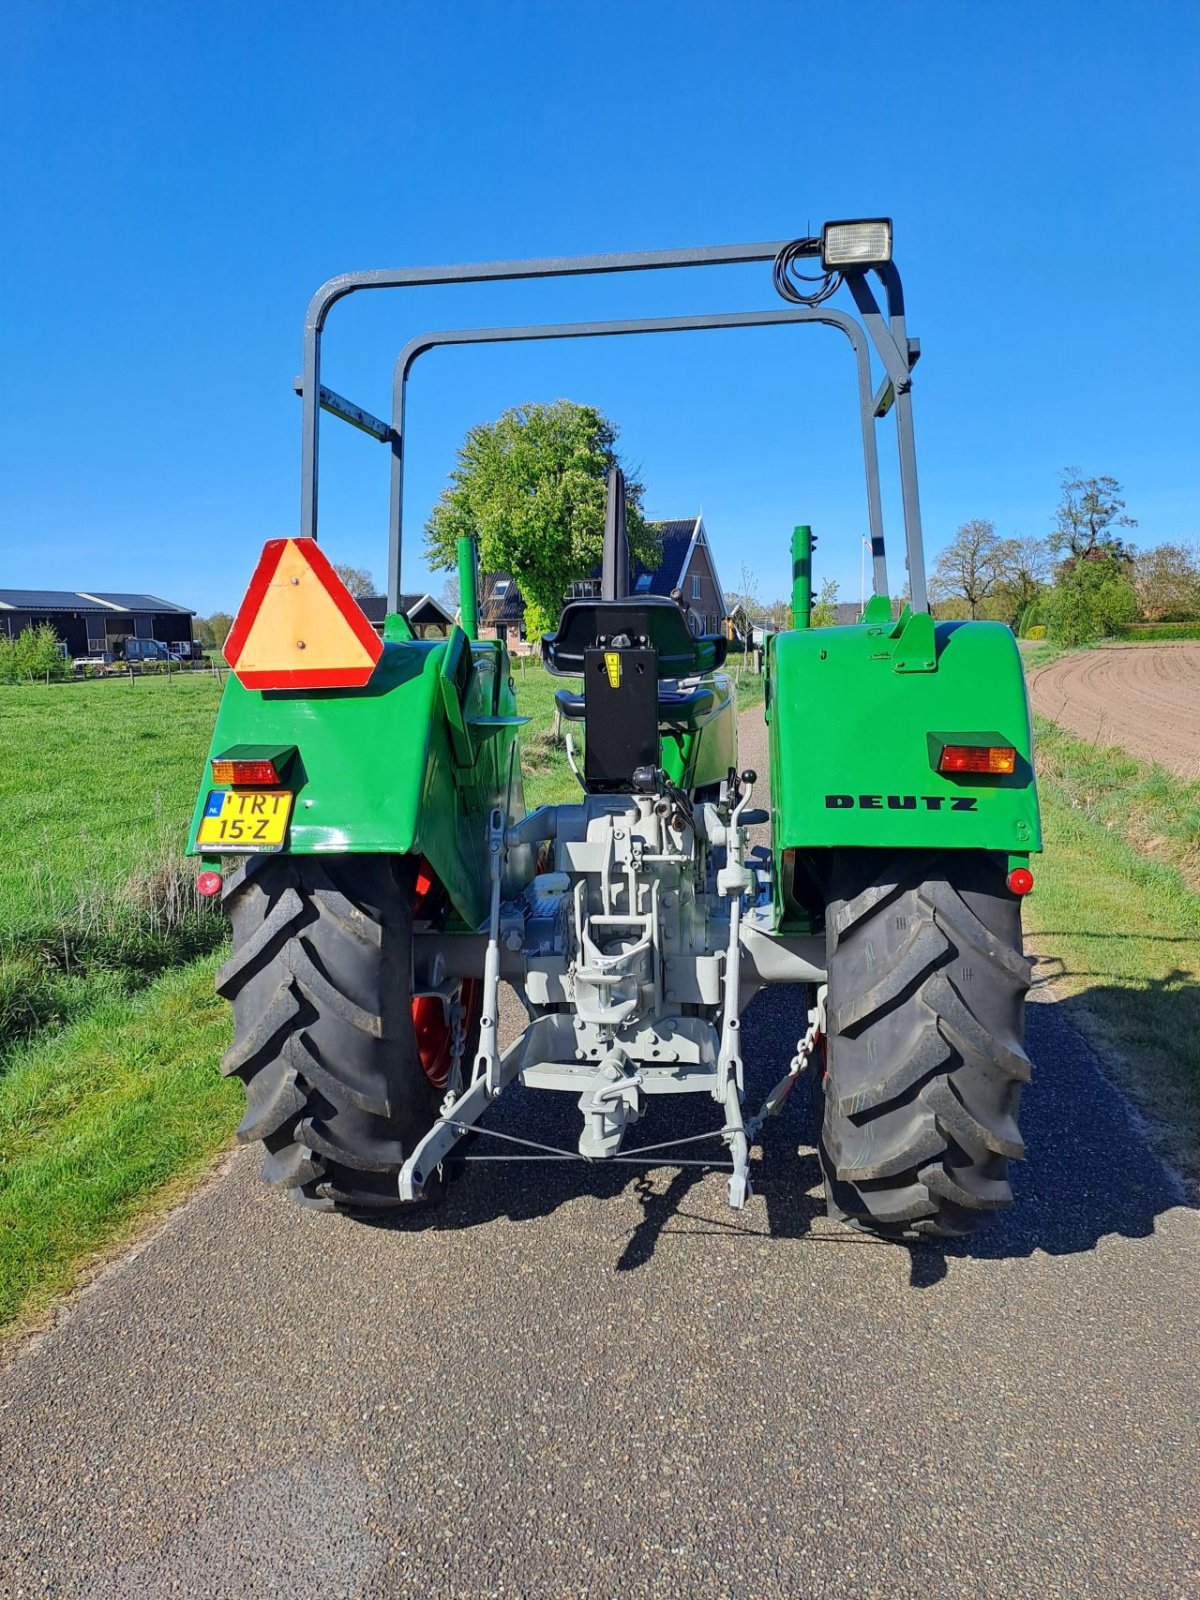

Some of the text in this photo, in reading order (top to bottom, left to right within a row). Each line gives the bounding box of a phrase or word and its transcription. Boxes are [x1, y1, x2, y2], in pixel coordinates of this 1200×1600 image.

[238, 795, 284, 814] TRT
[824, 795, 978, 812] DEUTZ
[219, 819, 270, 839] 15-Z
